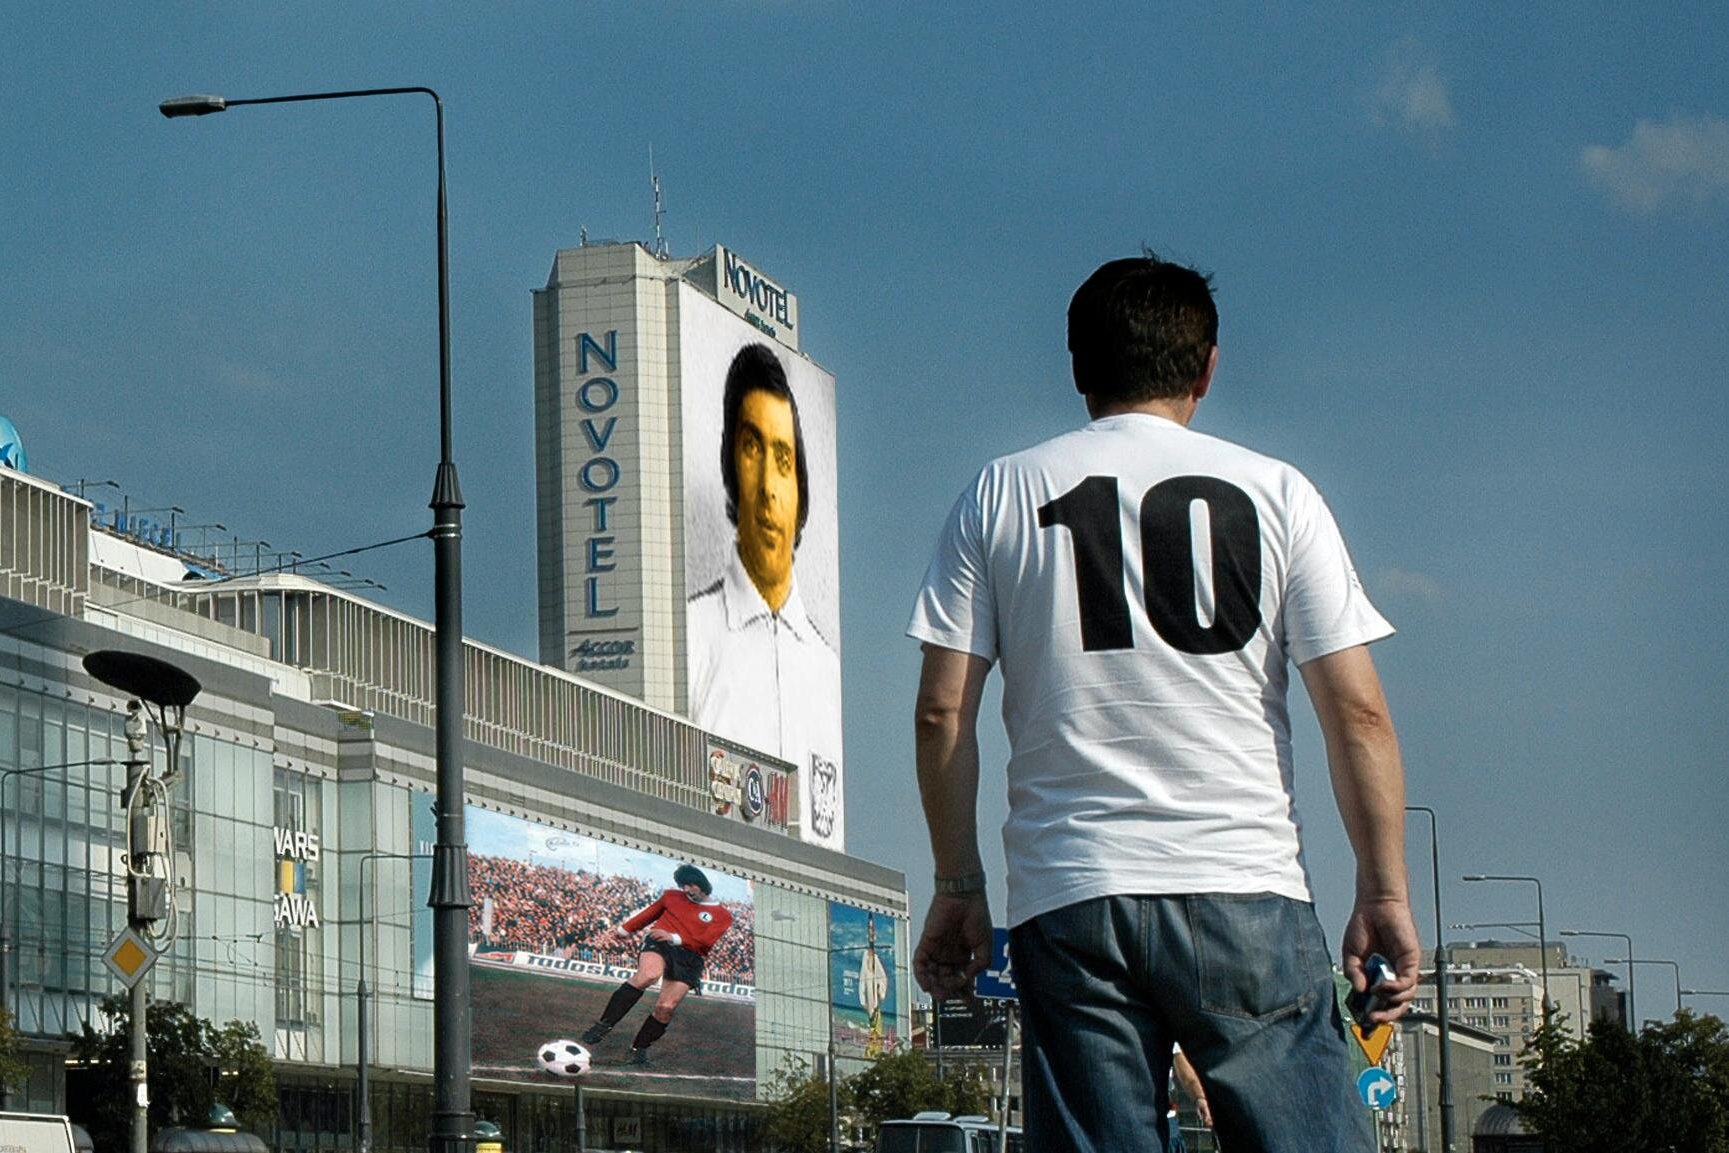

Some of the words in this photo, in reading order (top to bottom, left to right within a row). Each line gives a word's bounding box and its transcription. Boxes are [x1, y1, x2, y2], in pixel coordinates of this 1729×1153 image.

[724, 247, 793, 330] NOVOTEL
[575, 329, 621, 619] NOVOTEL
[1037, 475, 1262, 655] 10
[528, 955, 637, 981] radosko
